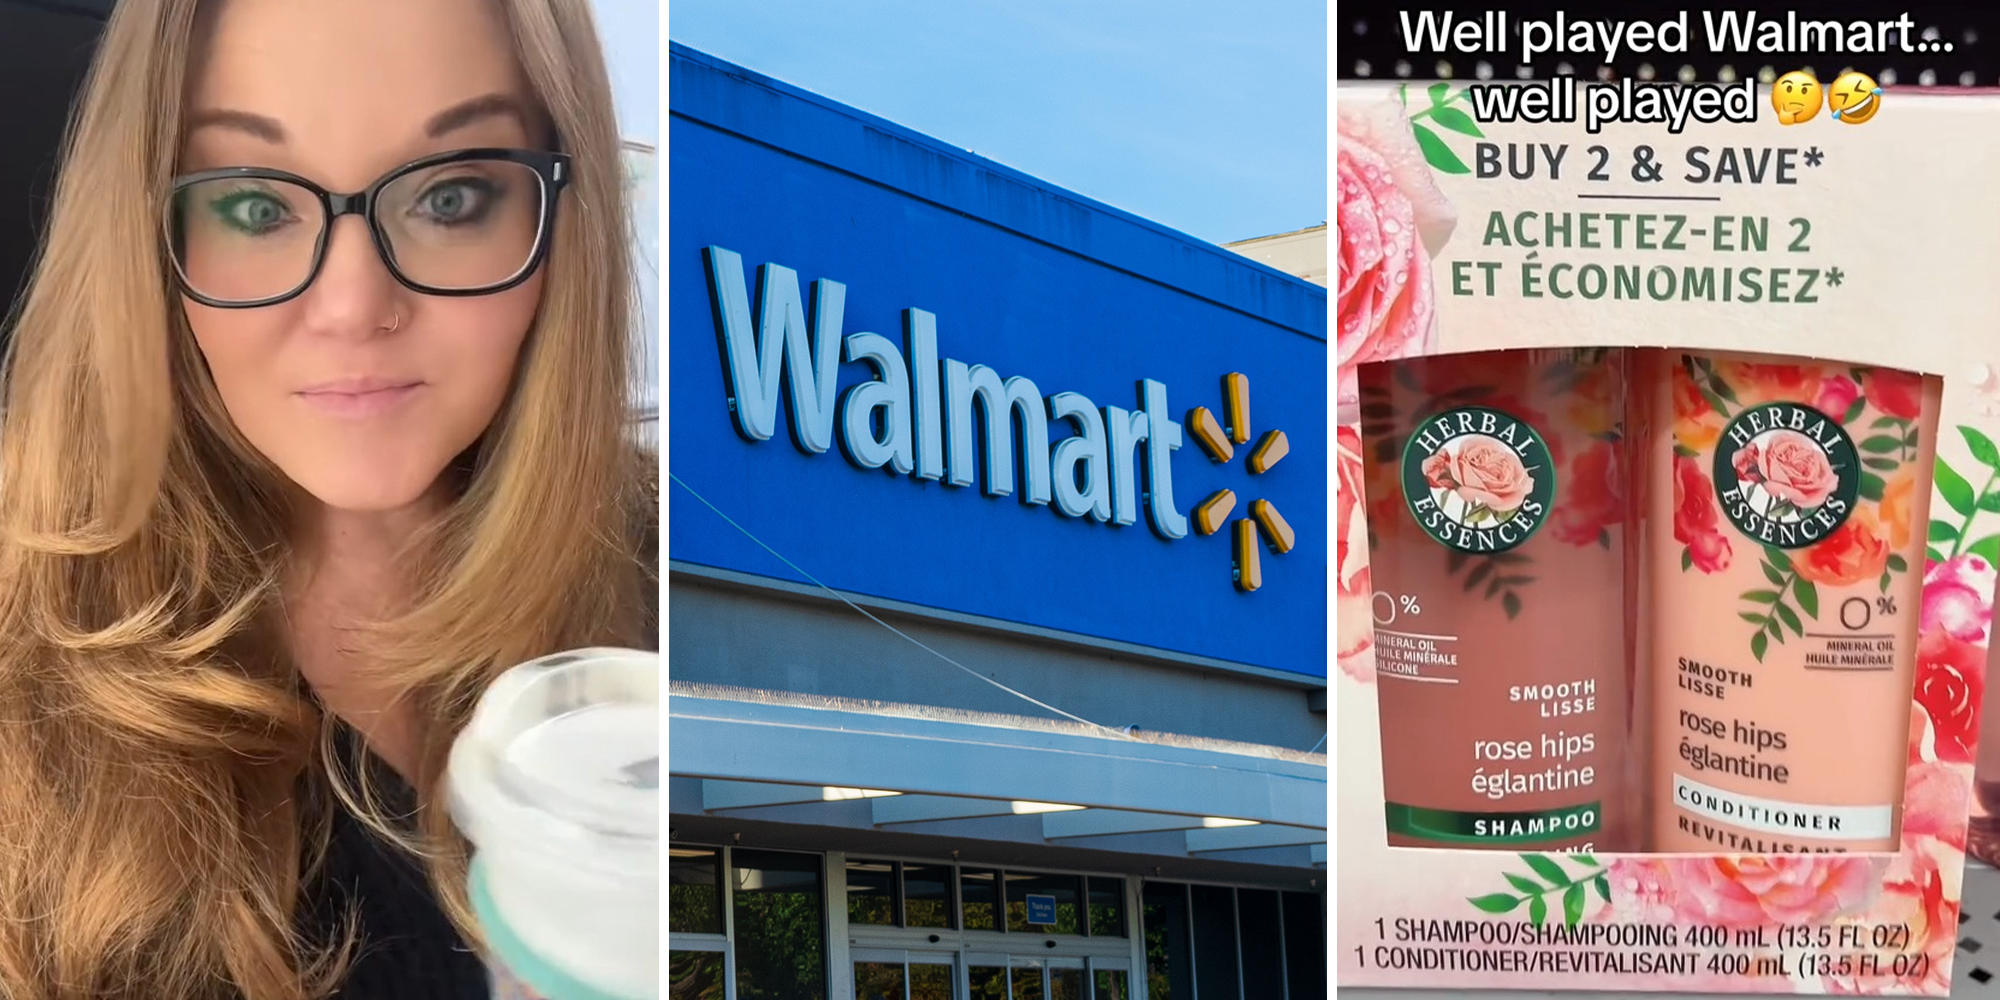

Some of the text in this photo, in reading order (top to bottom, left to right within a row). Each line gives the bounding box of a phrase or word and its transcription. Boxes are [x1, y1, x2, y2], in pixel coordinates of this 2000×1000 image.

[1475, 142, 1569, 180] BUY
[1587, 145, 1611, 182] 2
[1632, 145, 1663, 183] &
[1483, 211, 1812, 252] ACHETEZ-EN 2
[1452, 260, 1503, 296] ET
[703, 244, 1188, 540] Walmart
[1416, 411, 1535, 457] HERBAL
[1728, 406, 1843, 456] HERBAL
[1414, 495, 1543, 551] ESSENCES
[1722, 486, 1846, 545] ESSENCES
[1403, 650, 1458, 666] MINÉRALE
[1418, 640, 1437, 652] OIL
[1806, 652, 1895, 666] HUILE MINÉRALE
[1826, 640, 1895, 652] MINERAL OIL
[1509, 678, 1596, 701] SMOOTH
[1678, 656, 1753, 688] SMOOTH
[1678, 674, 1725, 700] LISSE
[1540, 697, 1596, 718] LISSE
[1474, 730, 1595, 761] rose hips
[1679, 708, 1788, 752] rose hips
[1678, 736, 1789, 784] églantine
[1471, 763, 1595, 799] églantine
[1474, 810, 1595, 836] SHAMPOO
[1678, 785, 1842, 831] CONDITIONER
[1374, 917, 1909, 951] 1 SHAMPOO/SHAMPOOING 400 mL (13.5 FL OZ)
[1354, 945, 1930, 979] 1 CONDITIONER/REVITALISANT 400 mL (13.5 FL OZ)
